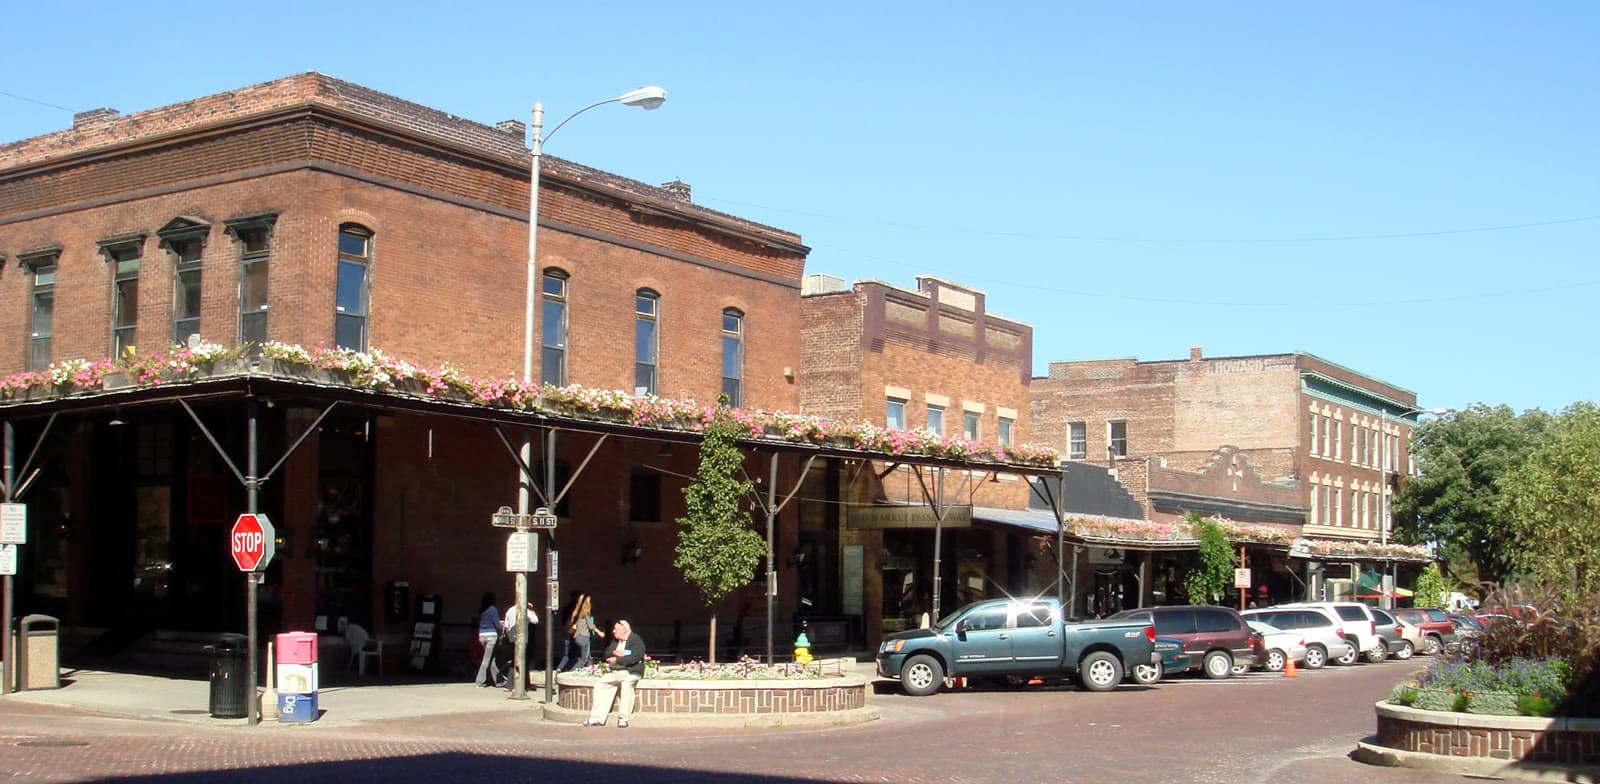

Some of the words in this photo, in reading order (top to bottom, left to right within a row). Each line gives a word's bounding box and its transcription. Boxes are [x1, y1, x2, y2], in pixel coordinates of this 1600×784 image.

[871, 511, 909, 521] MARKET
[911, 511, 968, 521] PASSAEWAY
[234, 532, 262, 553] STOP
[283, 695, 296, 714] Dig
